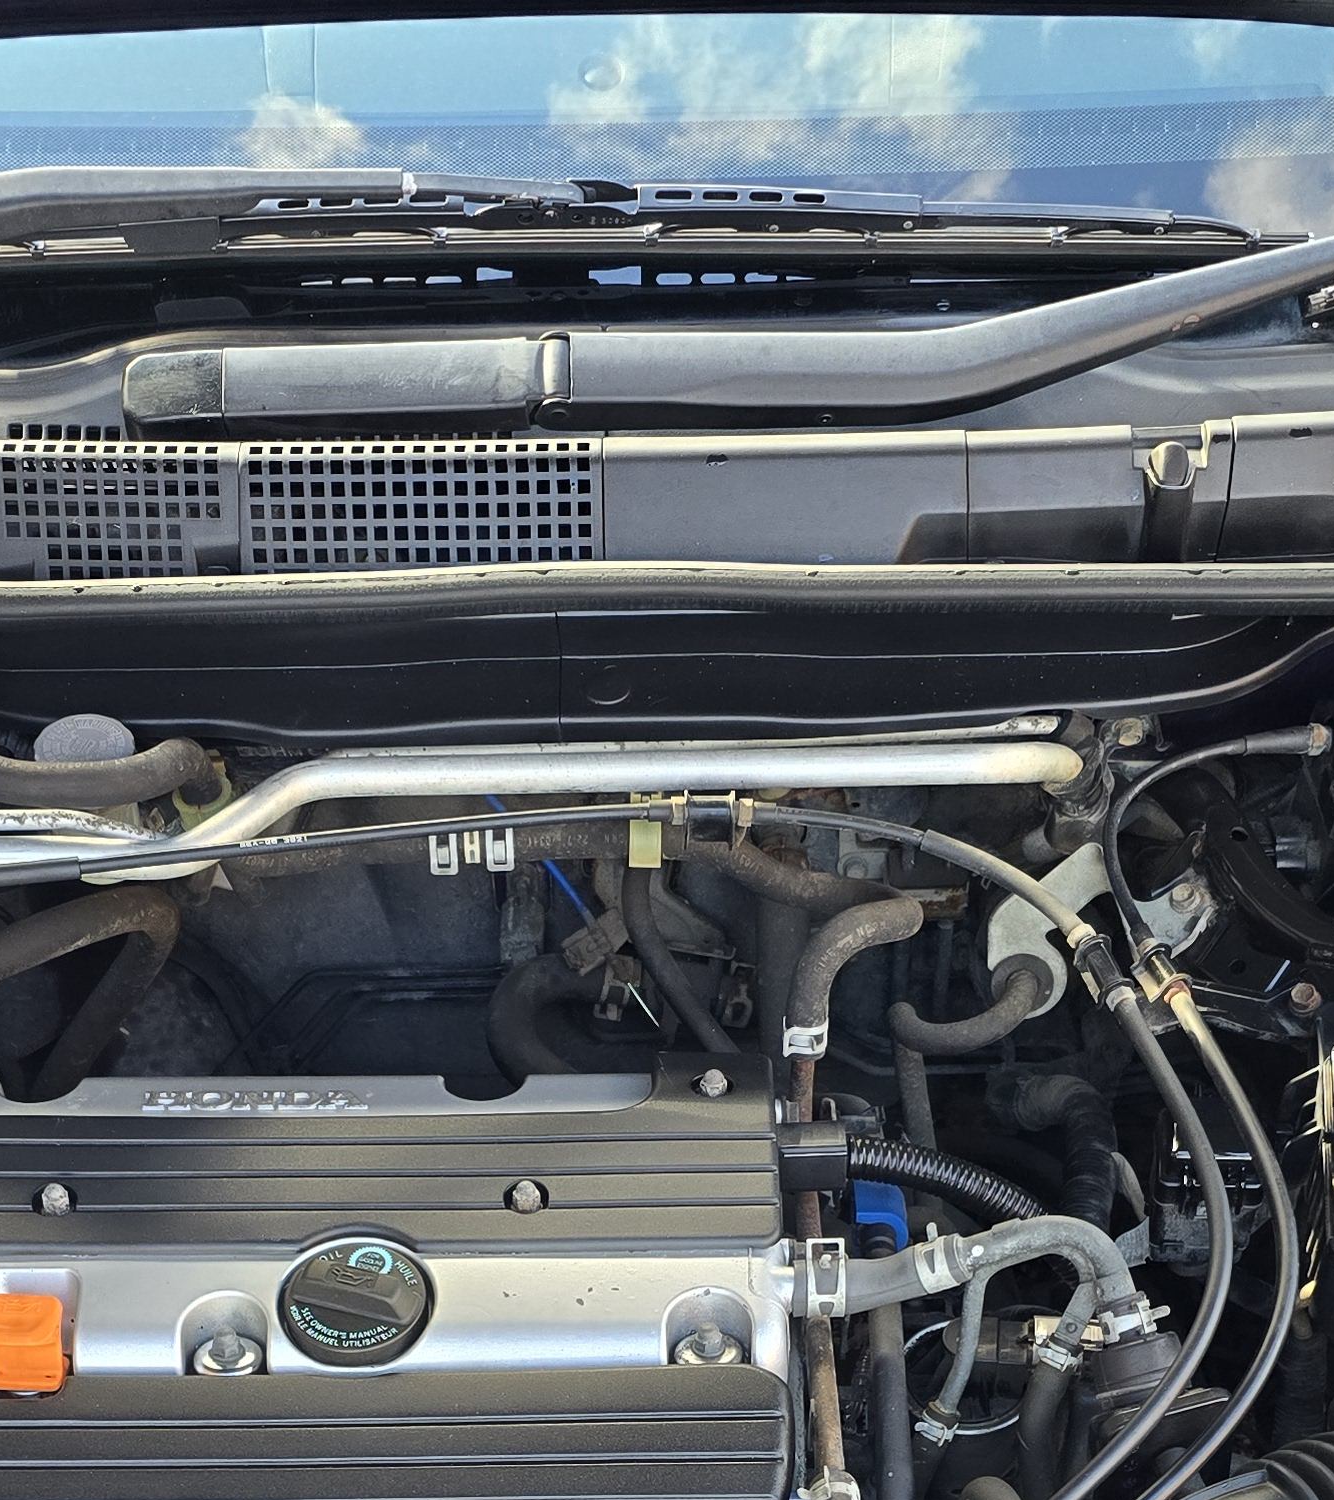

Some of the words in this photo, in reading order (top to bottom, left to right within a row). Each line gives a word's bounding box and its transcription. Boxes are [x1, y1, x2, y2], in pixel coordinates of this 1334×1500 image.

[141, 1090, 369, 1111] HONDA
[395, 1261, 418, 1287] HUILE
[290, 1305, 302, 1322] VOIR
[298, 1319, 306, 1331] LE
[306, 1328, 340, 1347] MANUEL
[342, 1327, 399, 1347] UTILISATEUR
[301, 1307, 314, 1323] SEE
[311, 1319, 348, 1339] OWNER'S
[349, 1324, 389, 1339] MANUAL
